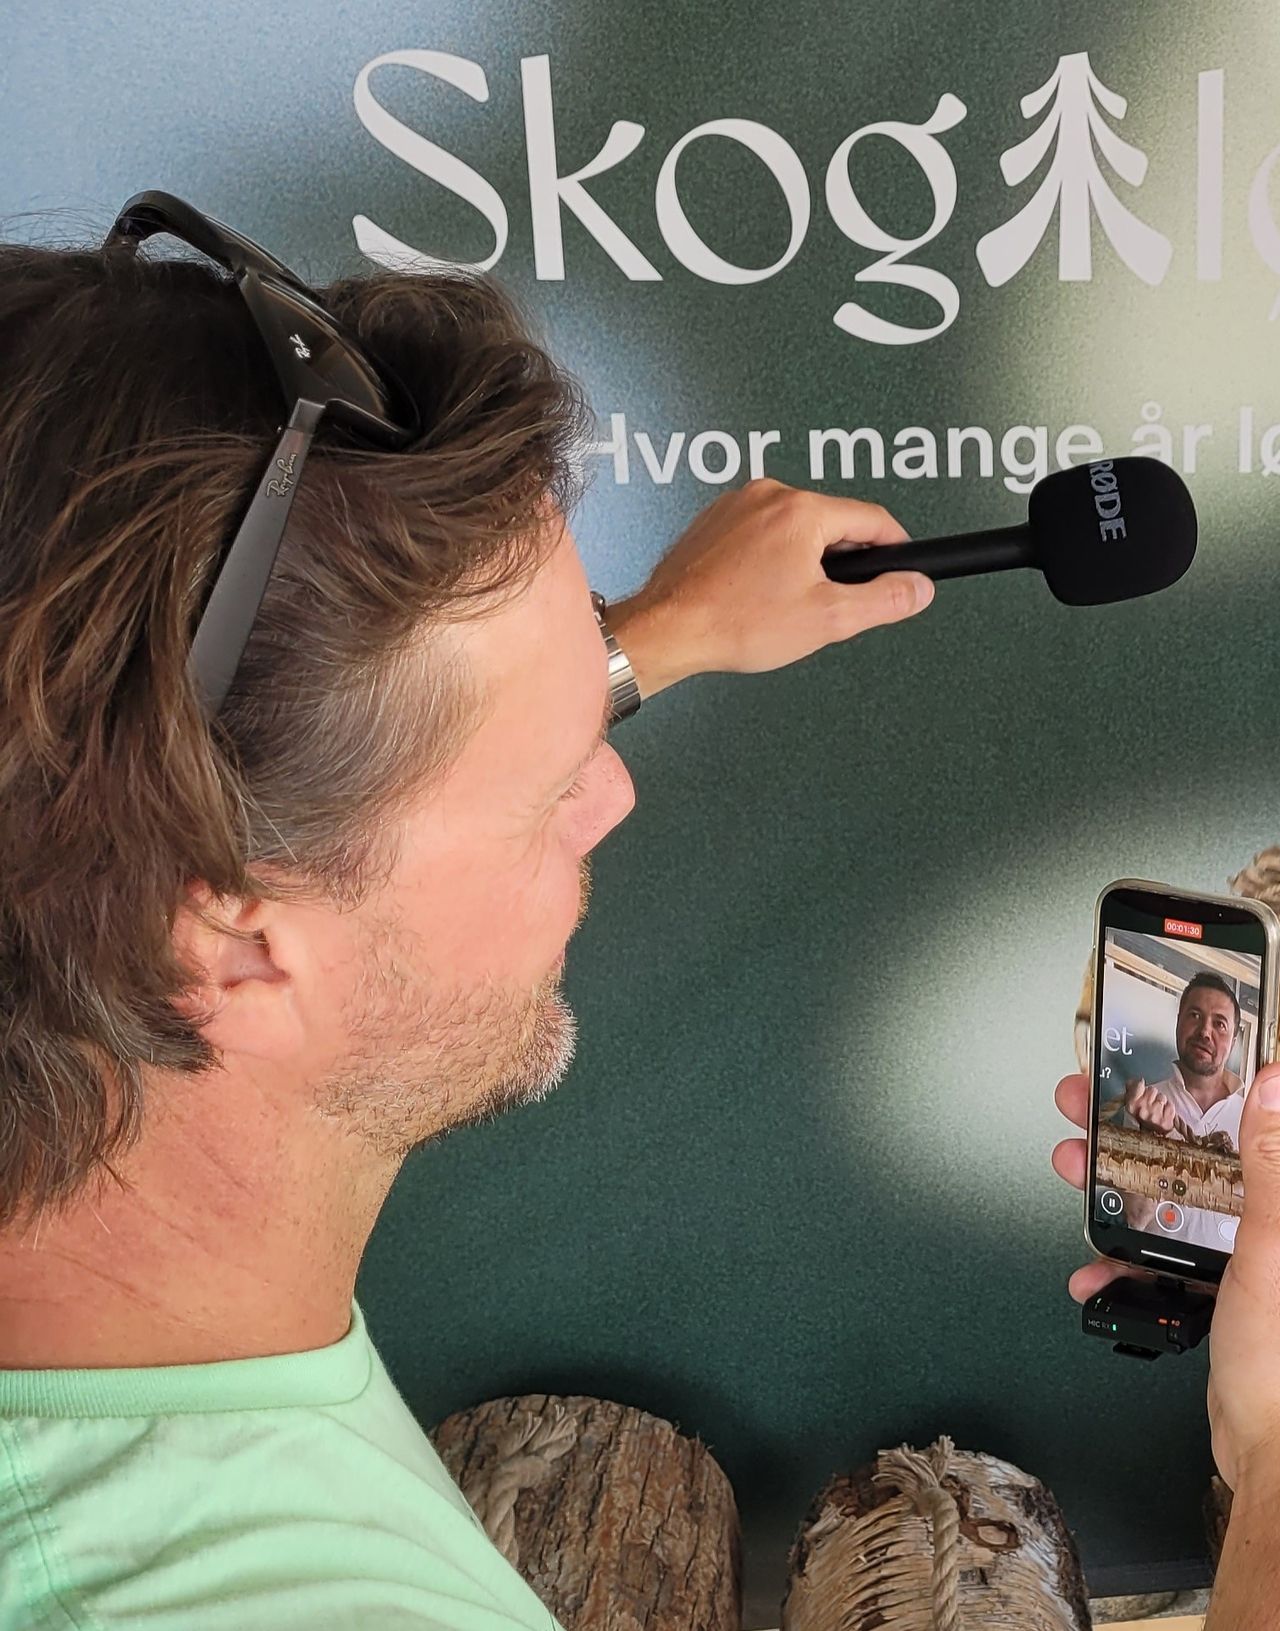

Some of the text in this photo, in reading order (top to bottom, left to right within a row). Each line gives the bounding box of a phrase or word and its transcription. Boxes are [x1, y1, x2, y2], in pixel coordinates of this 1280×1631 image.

[352, 49, 967, 345] Skog
[810, 423, 1103, 494] mange
[1130, 402, 1211, 475] år
[1088, 460, 1127, 542] RØDE
[1166, 921, 1200, 936] 00:01:30
[1104, 1026, 1134, 1055] et
